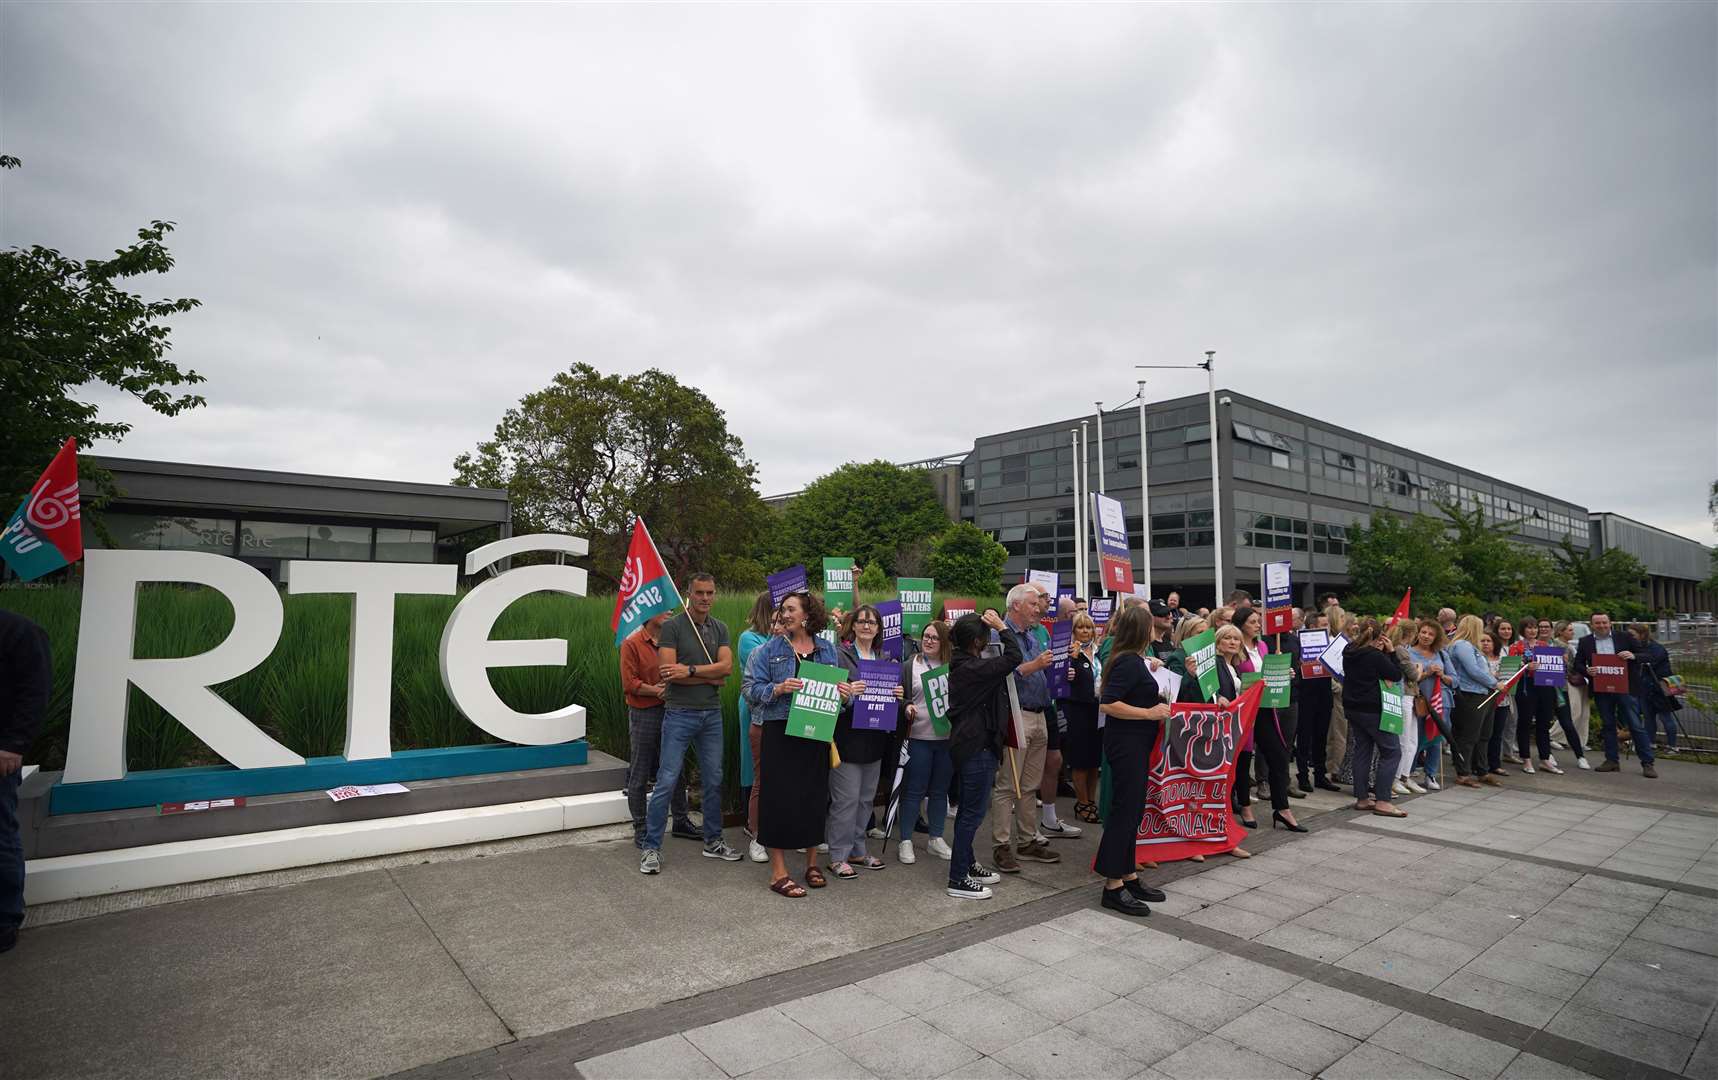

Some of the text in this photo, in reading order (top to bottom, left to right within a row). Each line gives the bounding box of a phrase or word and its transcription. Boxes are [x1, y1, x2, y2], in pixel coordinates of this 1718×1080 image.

[826, 569, 852, 581] TRUTH
[826, 581, 852, 590] MATTERS
[900, 590, 931, 602] TRUTH
[901, 603, 931, 612] MATTERS
[882, 613, 901, 628] UTH
[882, 626, 901, 639] TTERS
[1191, 642, 1216, 665] TRUTH
[1535, 654, 1564, 664] TRUTH
[1197, 655, 1216, 675] ATTERS
[1596, 666, 1625, 675] TRUST
[799, 677, 840, 701] TRUTH
[862, 680, 898, 688] RANSPARENCY
[864, 688, 895, 696] ANSPARENC
[1382, 690, 1401, 705] TRUTH
[795, 693, 839, 713] MATTERS
[858, 695, 896, 703] TRANSPARENCY
[867, 703, 875, 711] AT
[1152, 703, 1244, 777] NUJ
[1138, 812, 1226, 838] OURNALI
